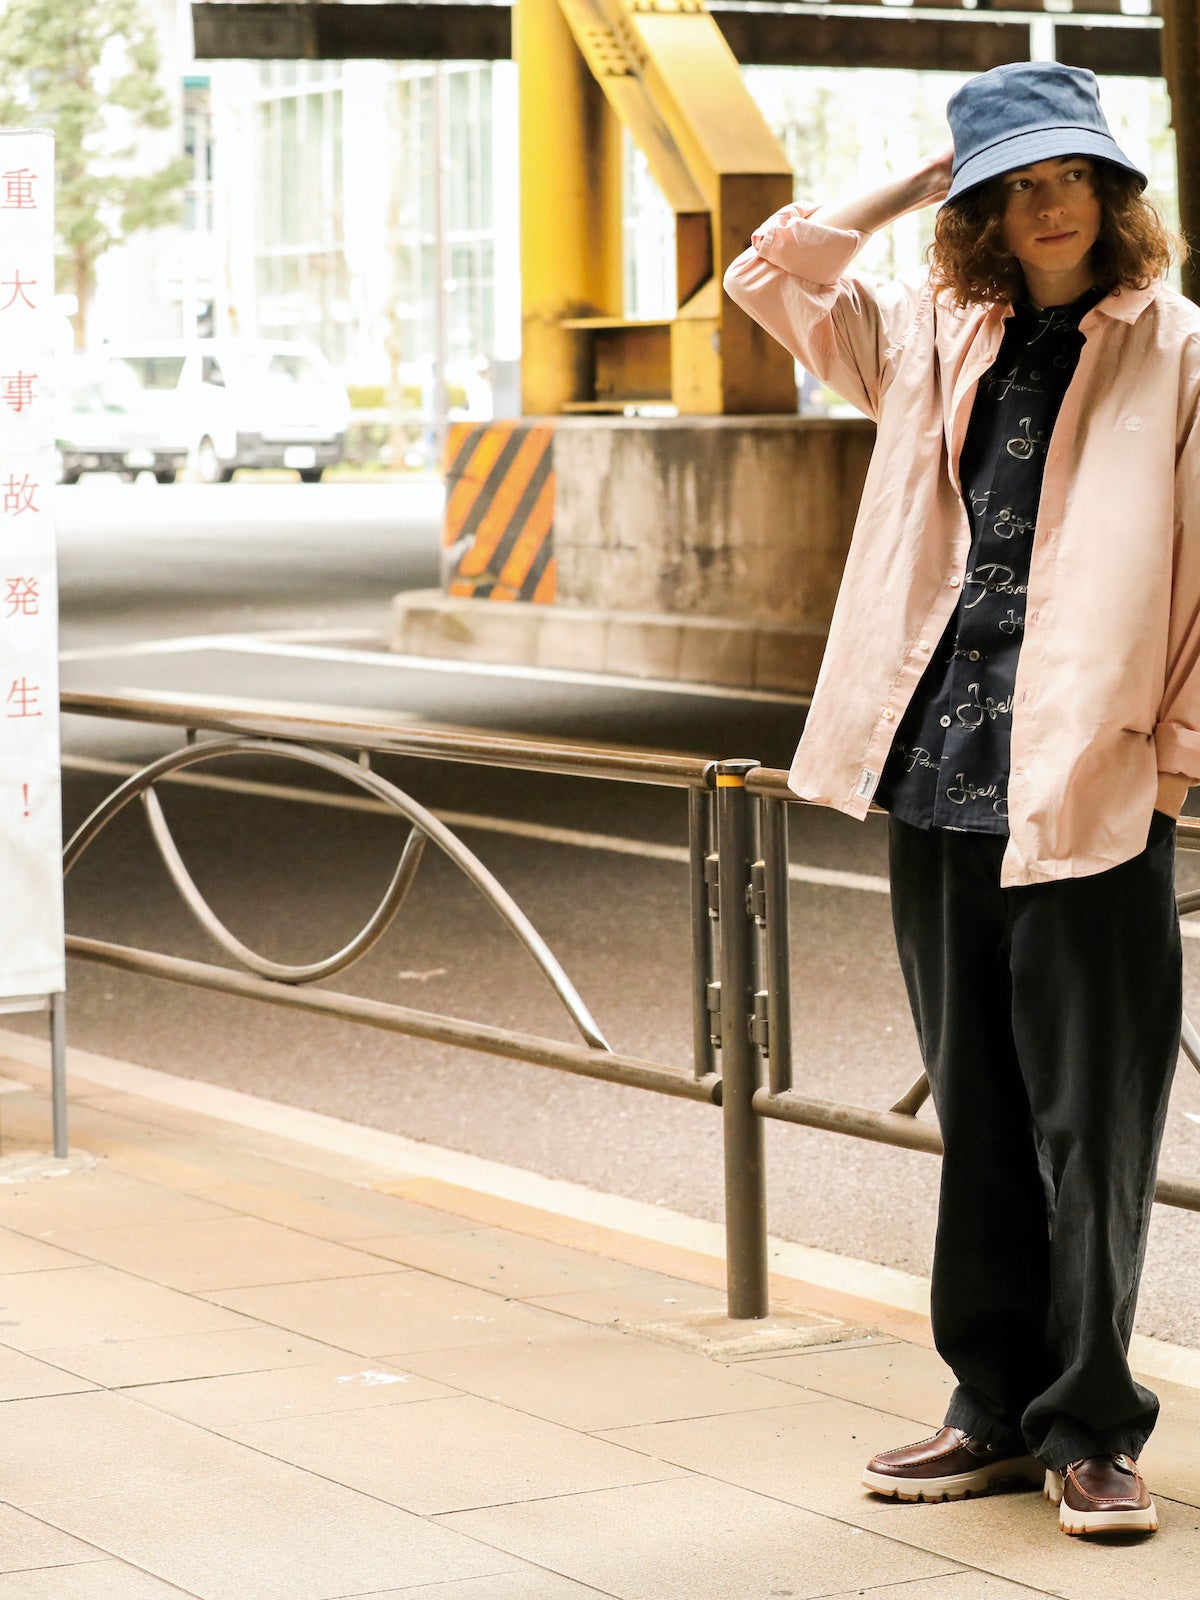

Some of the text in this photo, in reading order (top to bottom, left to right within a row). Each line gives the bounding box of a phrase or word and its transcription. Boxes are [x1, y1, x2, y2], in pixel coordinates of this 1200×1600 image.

[1, 168, 43, 817] 重大事故発生!
